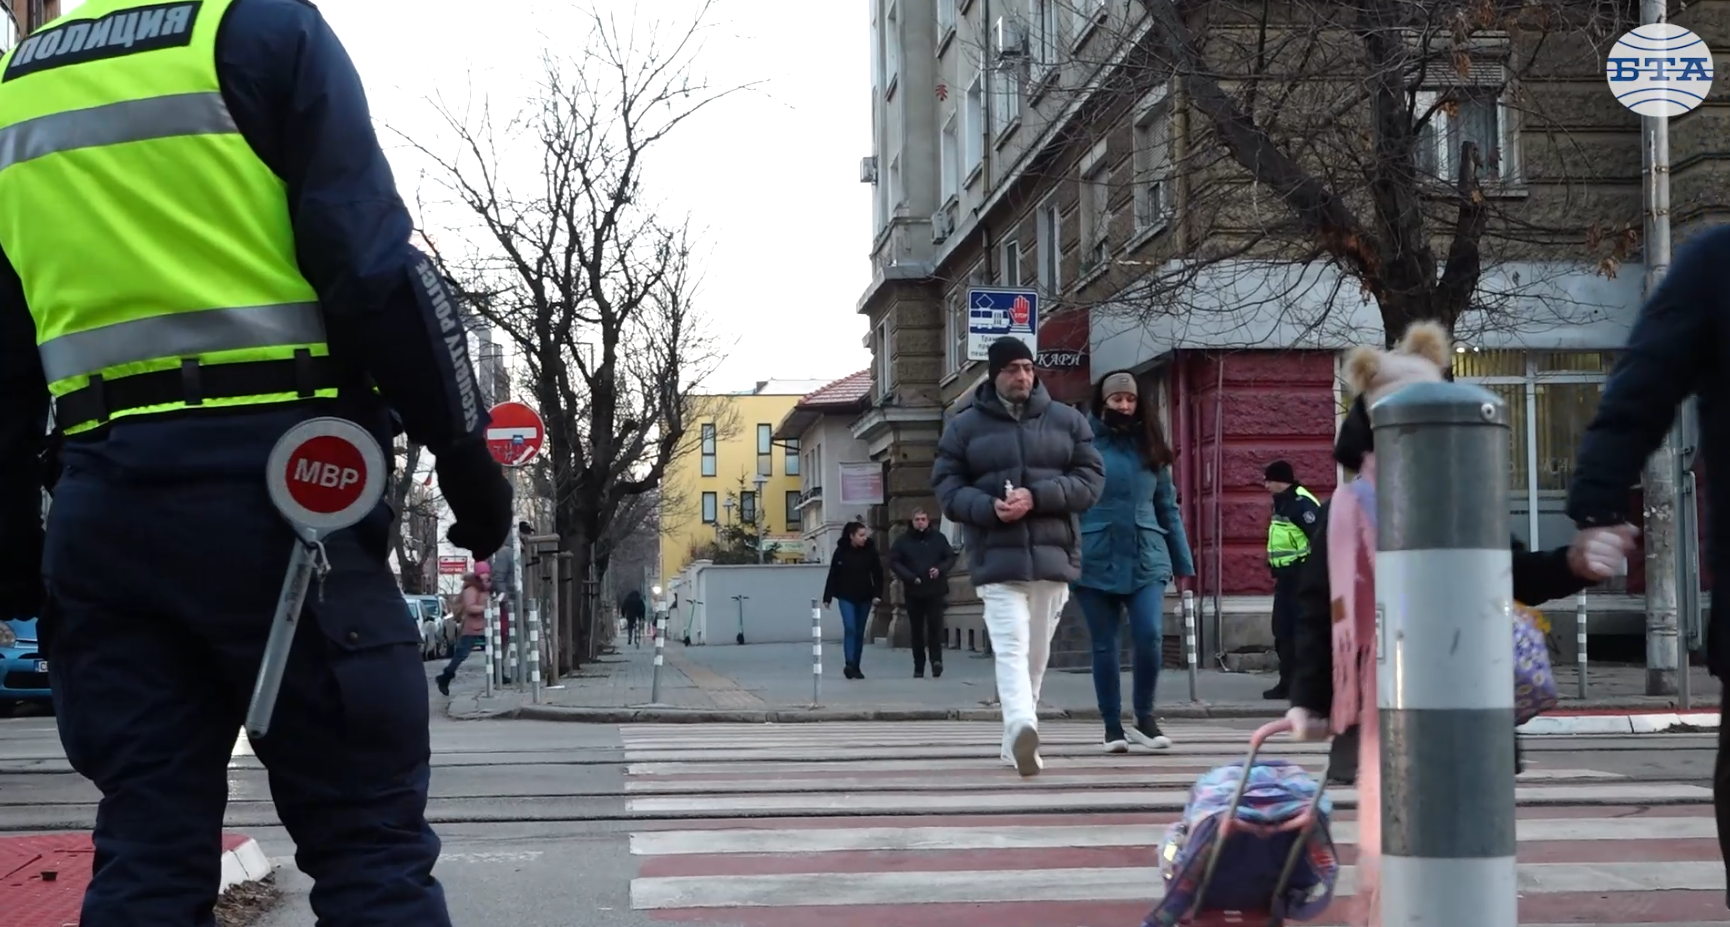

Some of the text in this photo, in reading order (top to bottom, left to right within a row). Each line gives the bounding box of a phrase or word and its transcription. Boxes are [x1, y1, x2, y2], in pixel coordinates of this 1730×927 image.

[10, 5, 193, 68] ПОЛИЦИЯ
[416, 259, 478, 433] SECURITY POLICE
[1038, 353, 1080, 368] КАРИ
[294, 458, 359, 490] МВР
